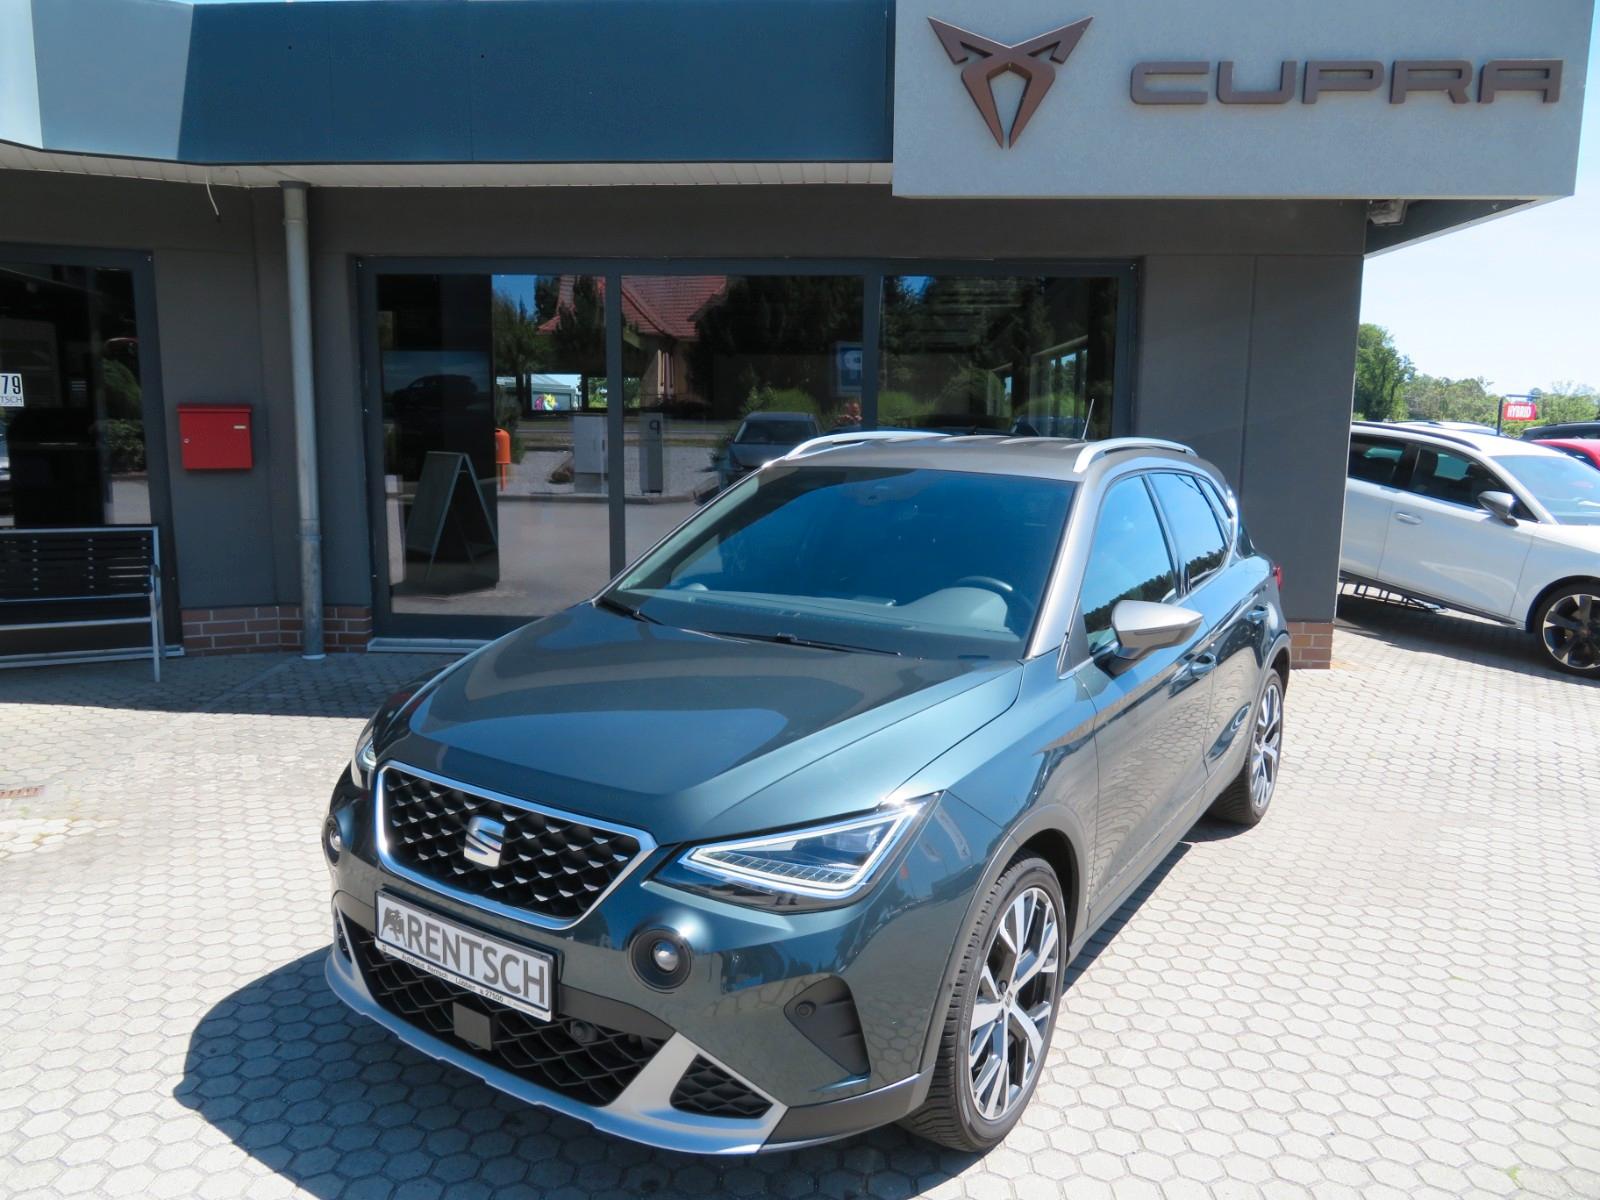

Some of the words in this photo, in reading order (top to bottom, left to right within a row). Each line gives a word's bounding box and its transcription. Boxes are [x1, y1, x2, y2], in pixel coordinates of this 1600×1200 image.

[1131, 60, 1563, 104] CUPRA
[1, 375, 21, 394] 79
[406, 913, 545, 1004] RENTSCH
